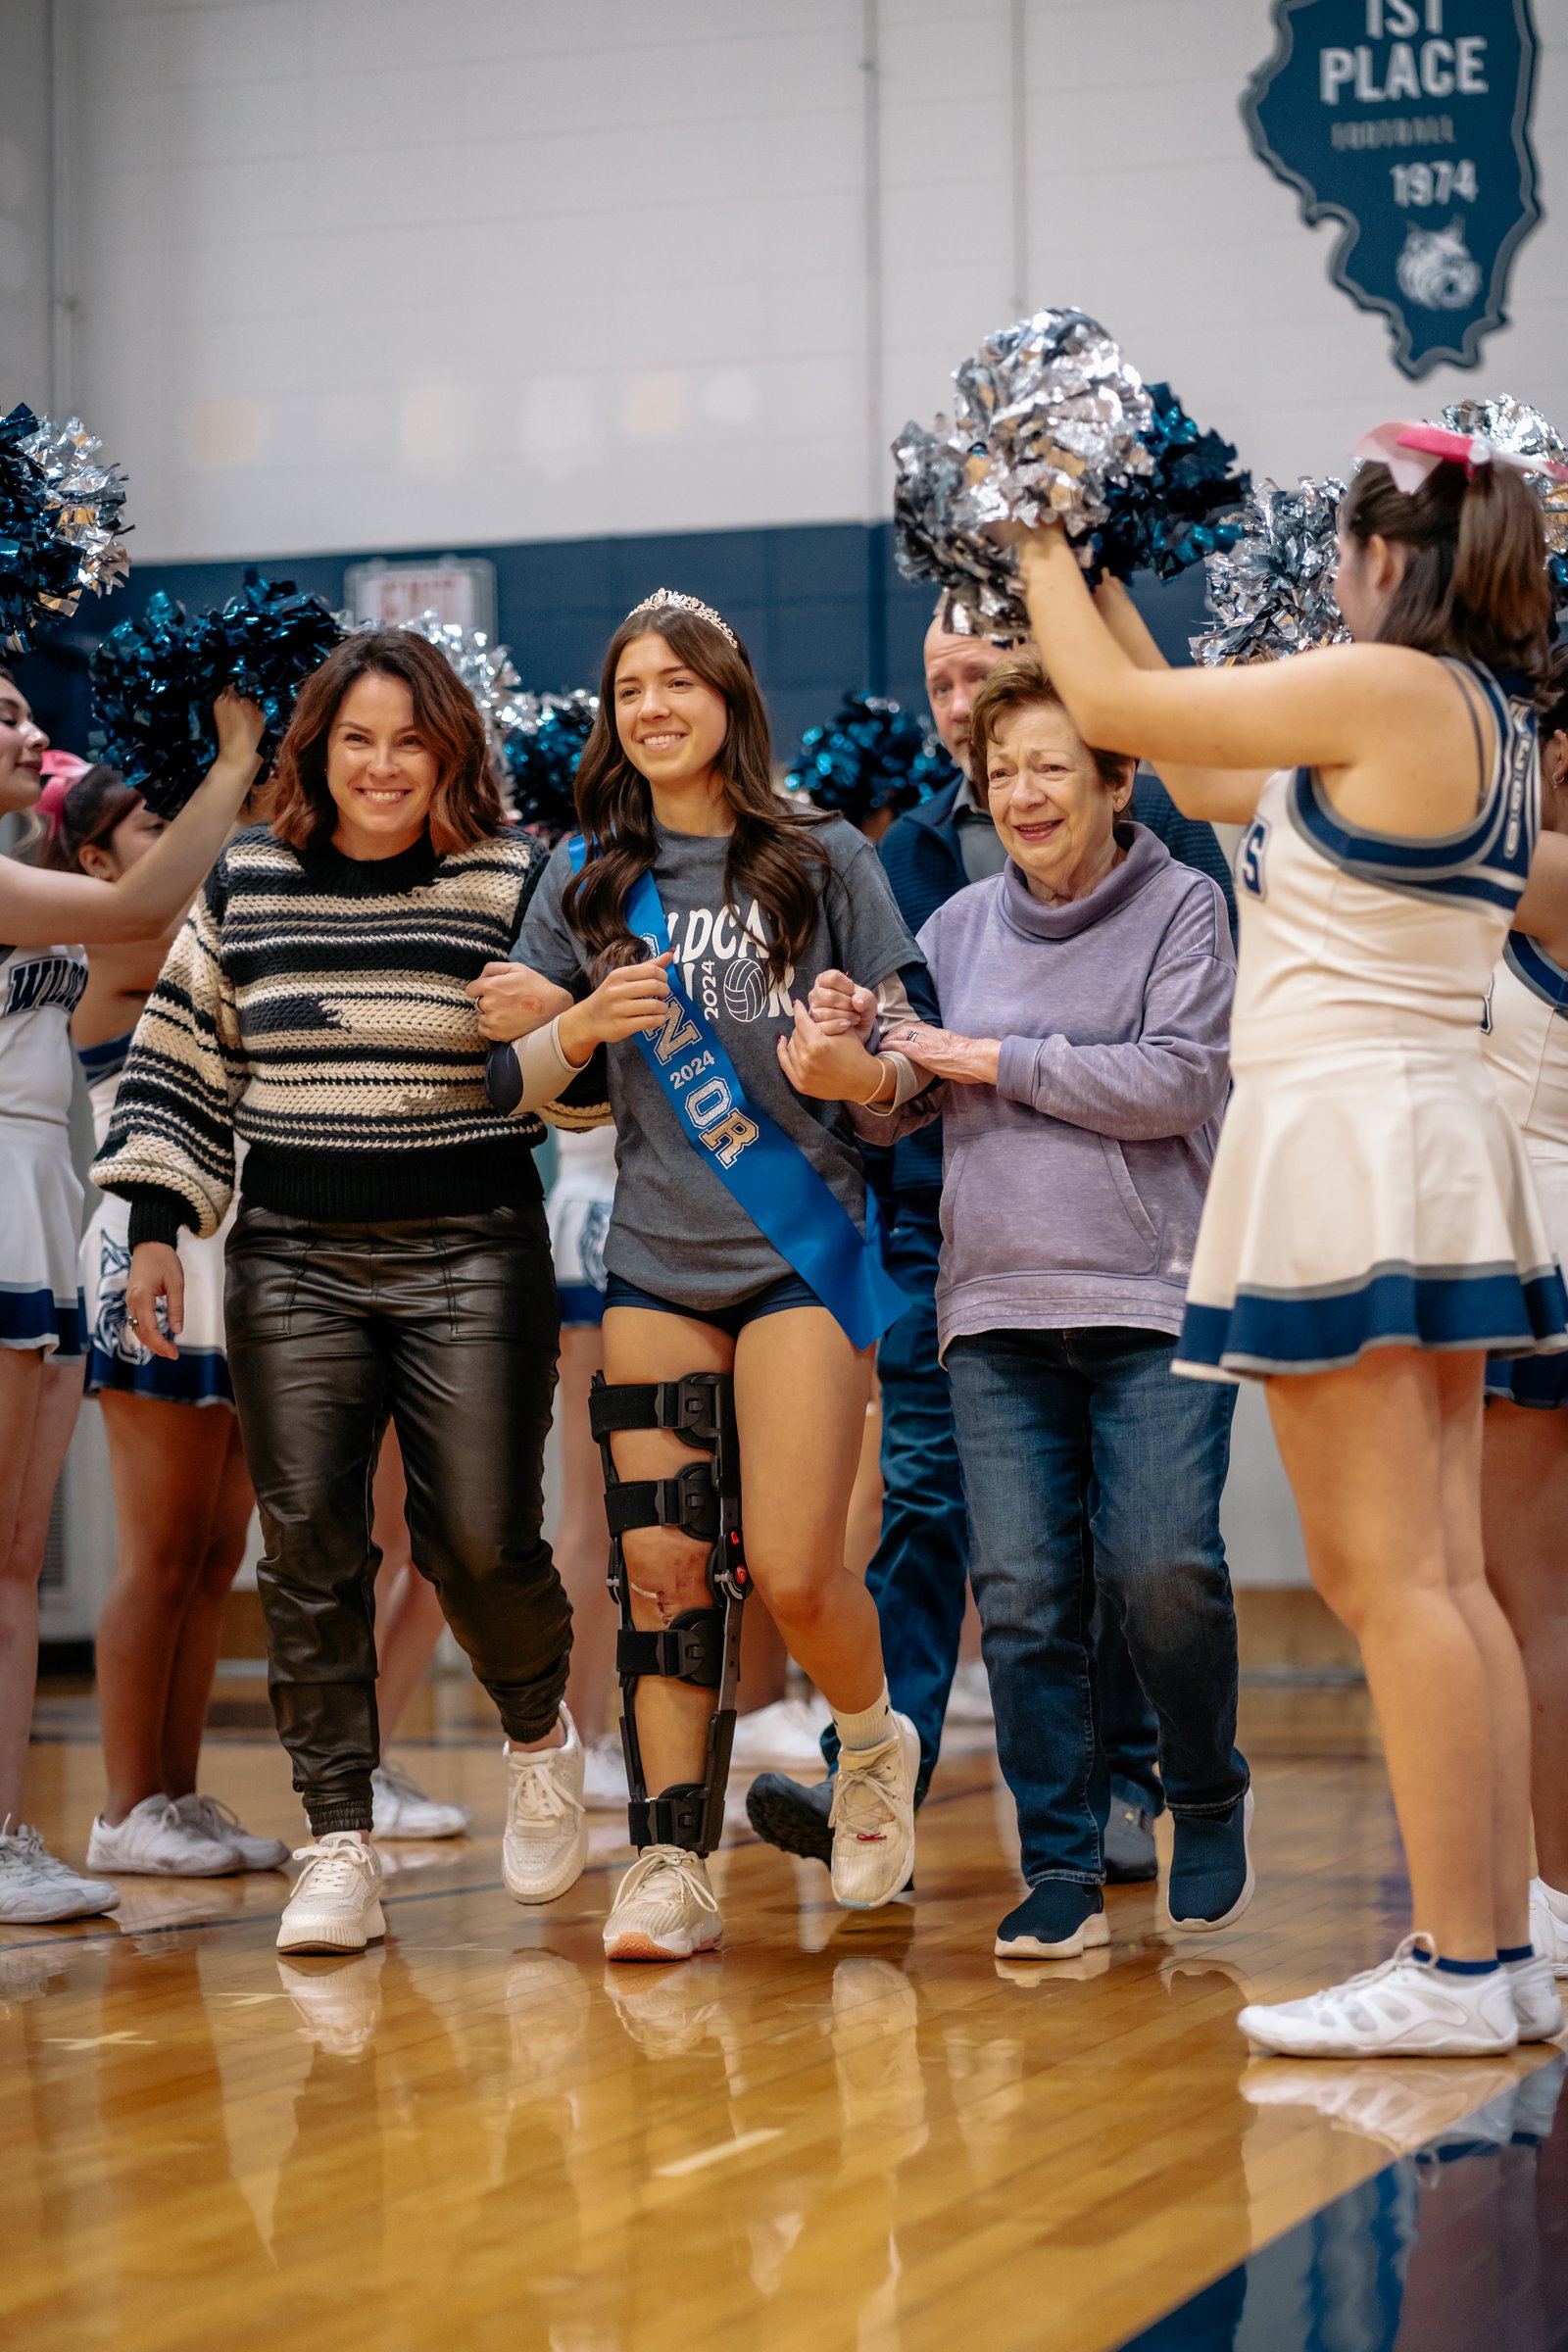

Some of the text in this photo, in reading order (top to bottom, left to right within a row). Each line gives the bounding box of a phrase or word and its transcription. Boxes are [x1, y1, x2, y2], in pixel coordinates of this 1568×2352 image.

[1319, 35, 1489, 105] PLACE
[1390, 159, 1479, 208] 1974
[701, 959, 720, 1021] 2024
[669, 1050, 715, 1090] 2024
